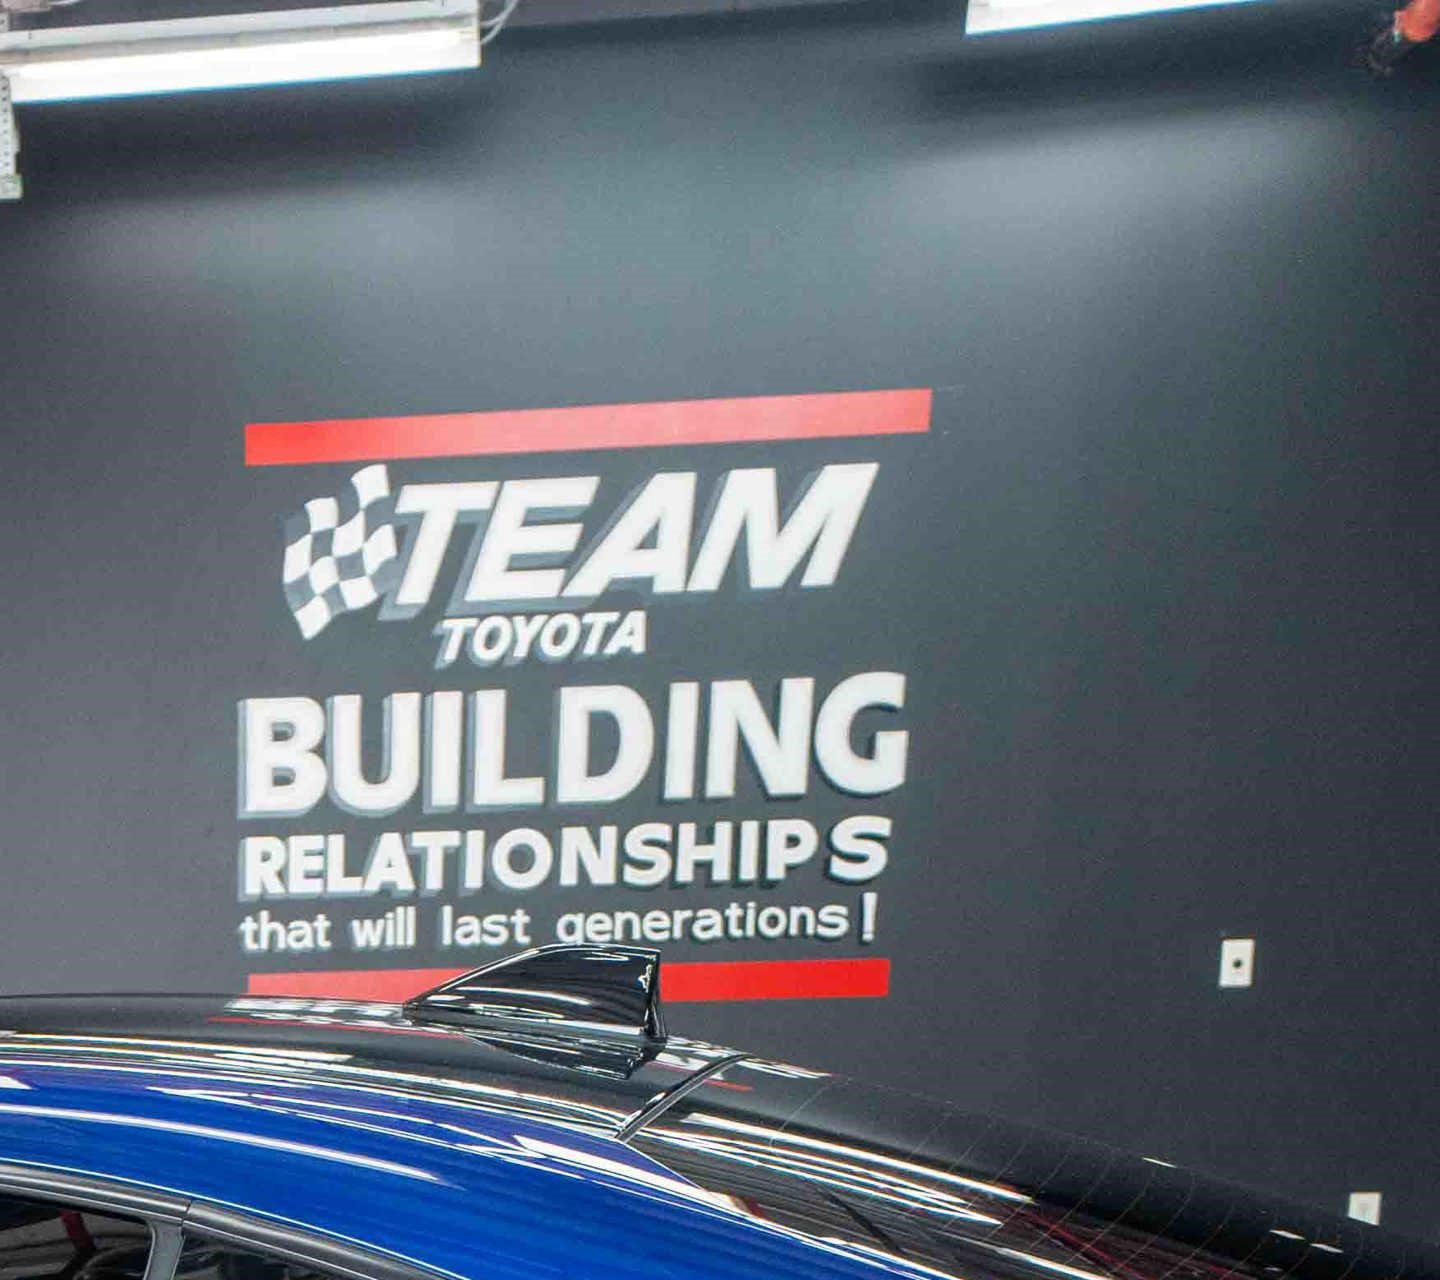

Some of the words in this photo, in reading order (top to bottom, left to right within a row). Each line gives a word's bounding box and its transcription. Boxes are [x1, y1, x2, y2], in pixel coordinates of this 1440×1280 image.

[390, 463, 879, 607] TEAM
[439, 611, 648, 665] TOYOTA
[241, 673, 909, 815] BUILDING
[241, 816, 893, 896] RELATIONSHIPS
[239, 910, 332, 951] that
[351, 905, 417, 948] will
[441, 905, 532, 947] last
